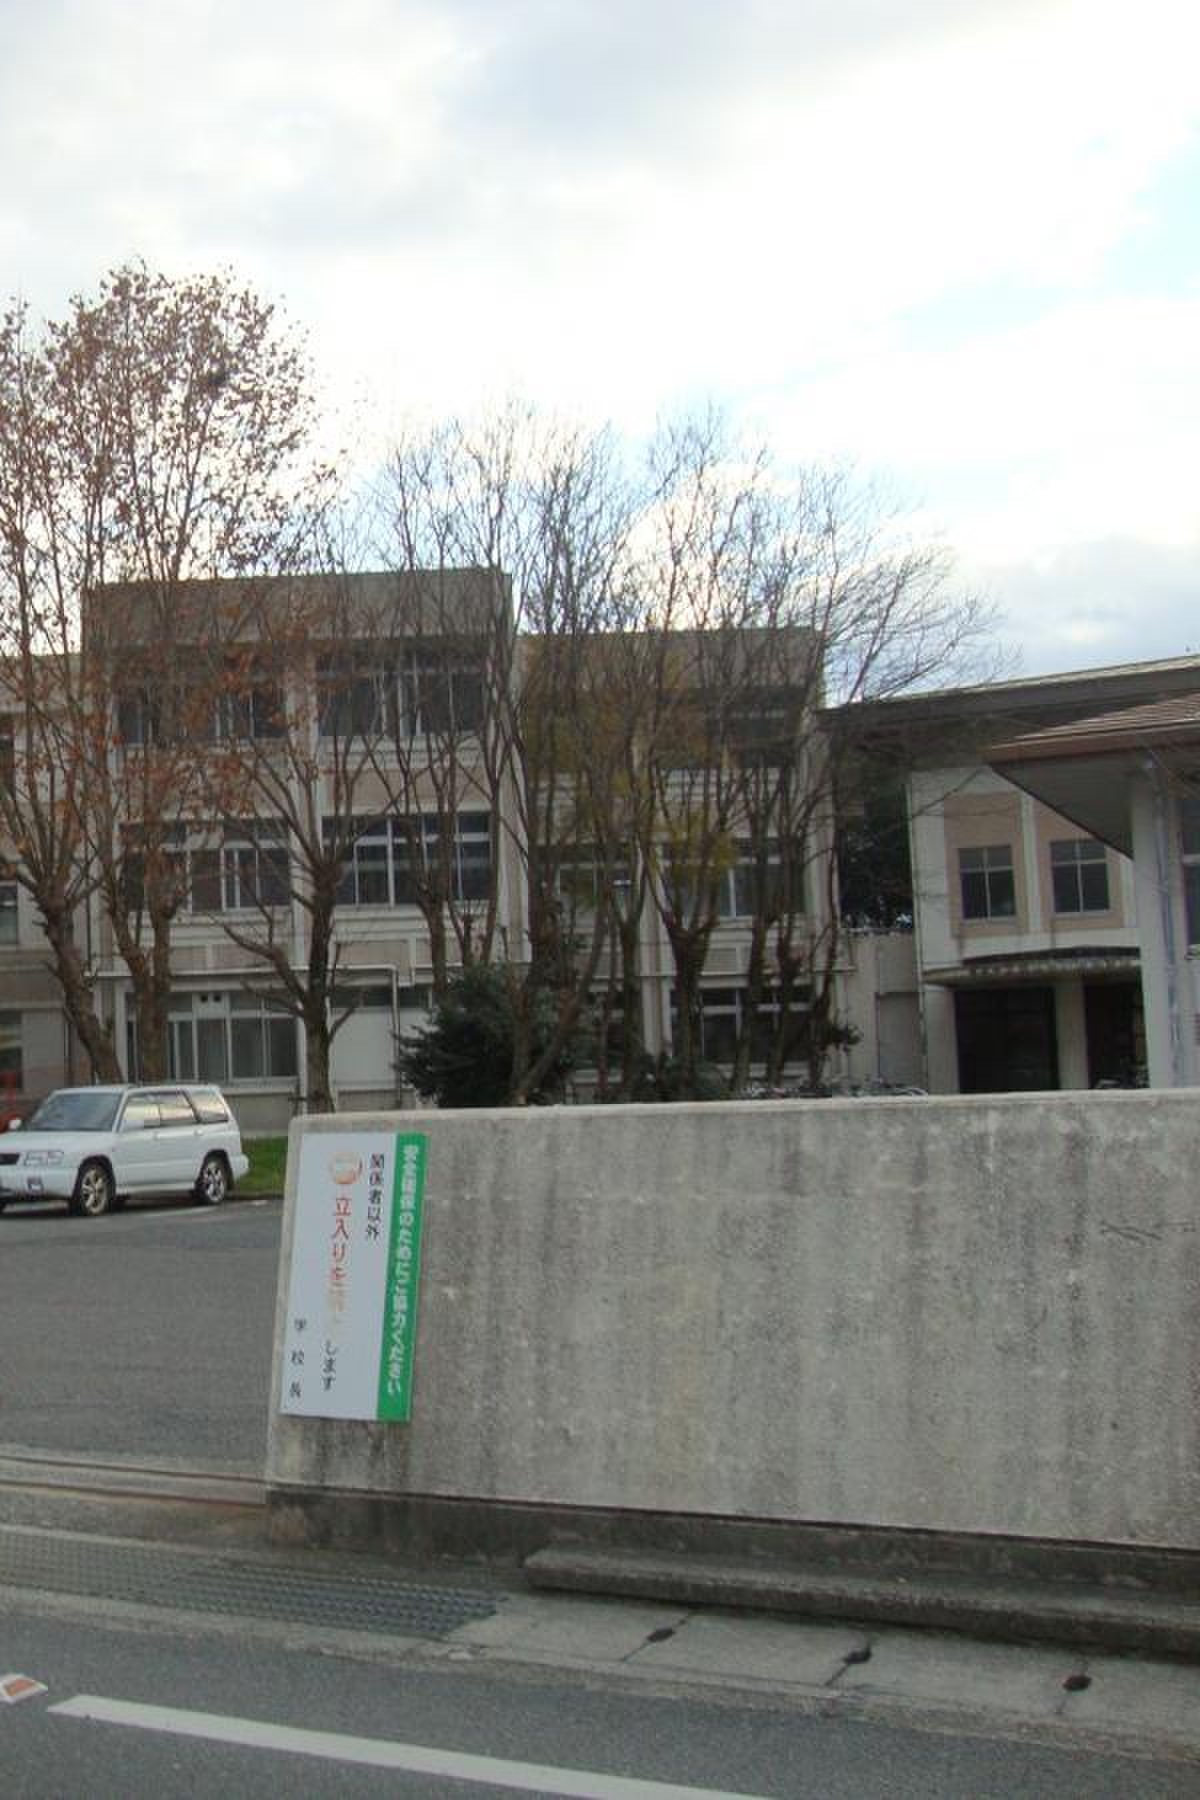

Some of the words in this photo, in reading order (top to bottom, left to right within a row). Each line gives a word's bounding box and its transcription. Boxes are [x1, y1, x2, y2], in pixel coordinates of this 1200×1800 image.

[366, 1152, 385, 1240] 関係者以外
